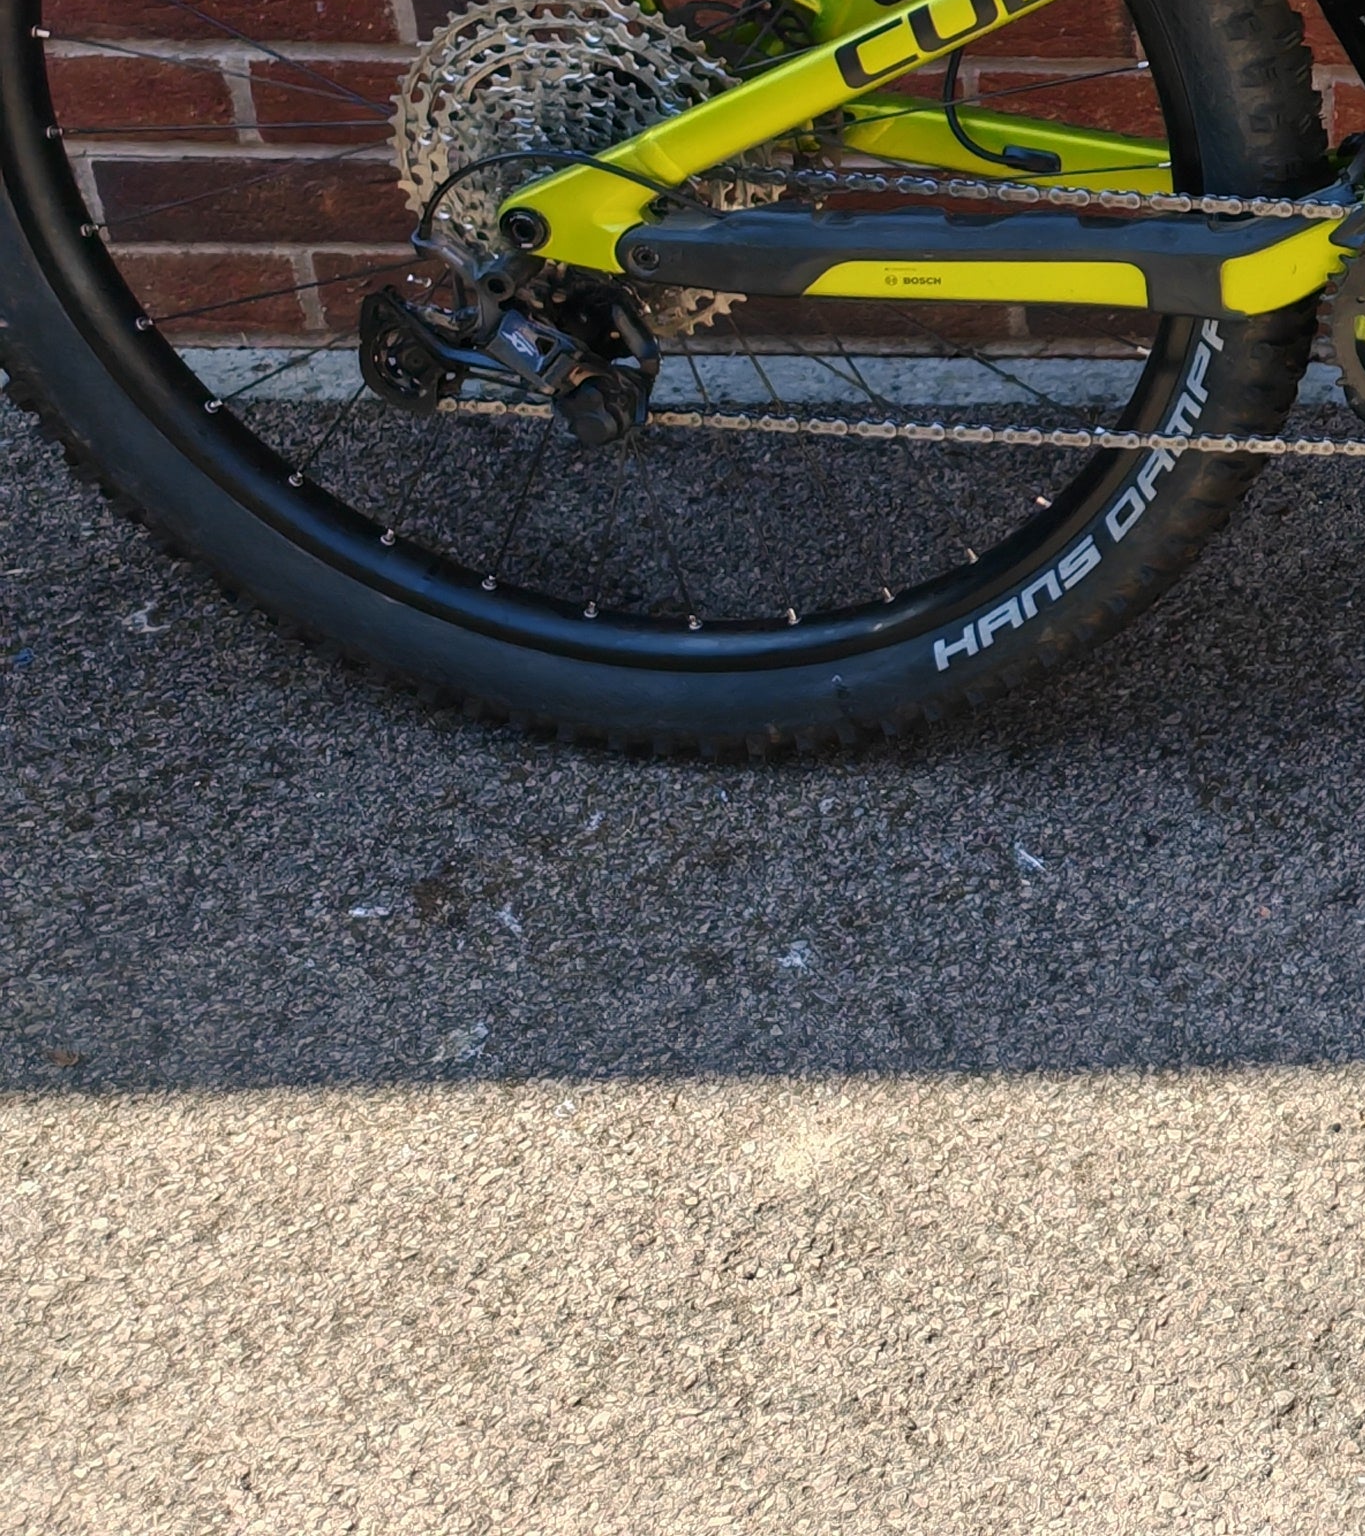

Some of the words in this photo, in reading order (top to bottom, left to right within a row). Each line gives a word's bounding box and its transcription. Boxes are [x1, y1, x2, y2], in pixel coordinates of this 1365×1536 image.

[903, 276, 942, 285] BOSCH
[933, 534, 1102, 672] HANS
[1105, 319, 1224, 543] DAMPF
